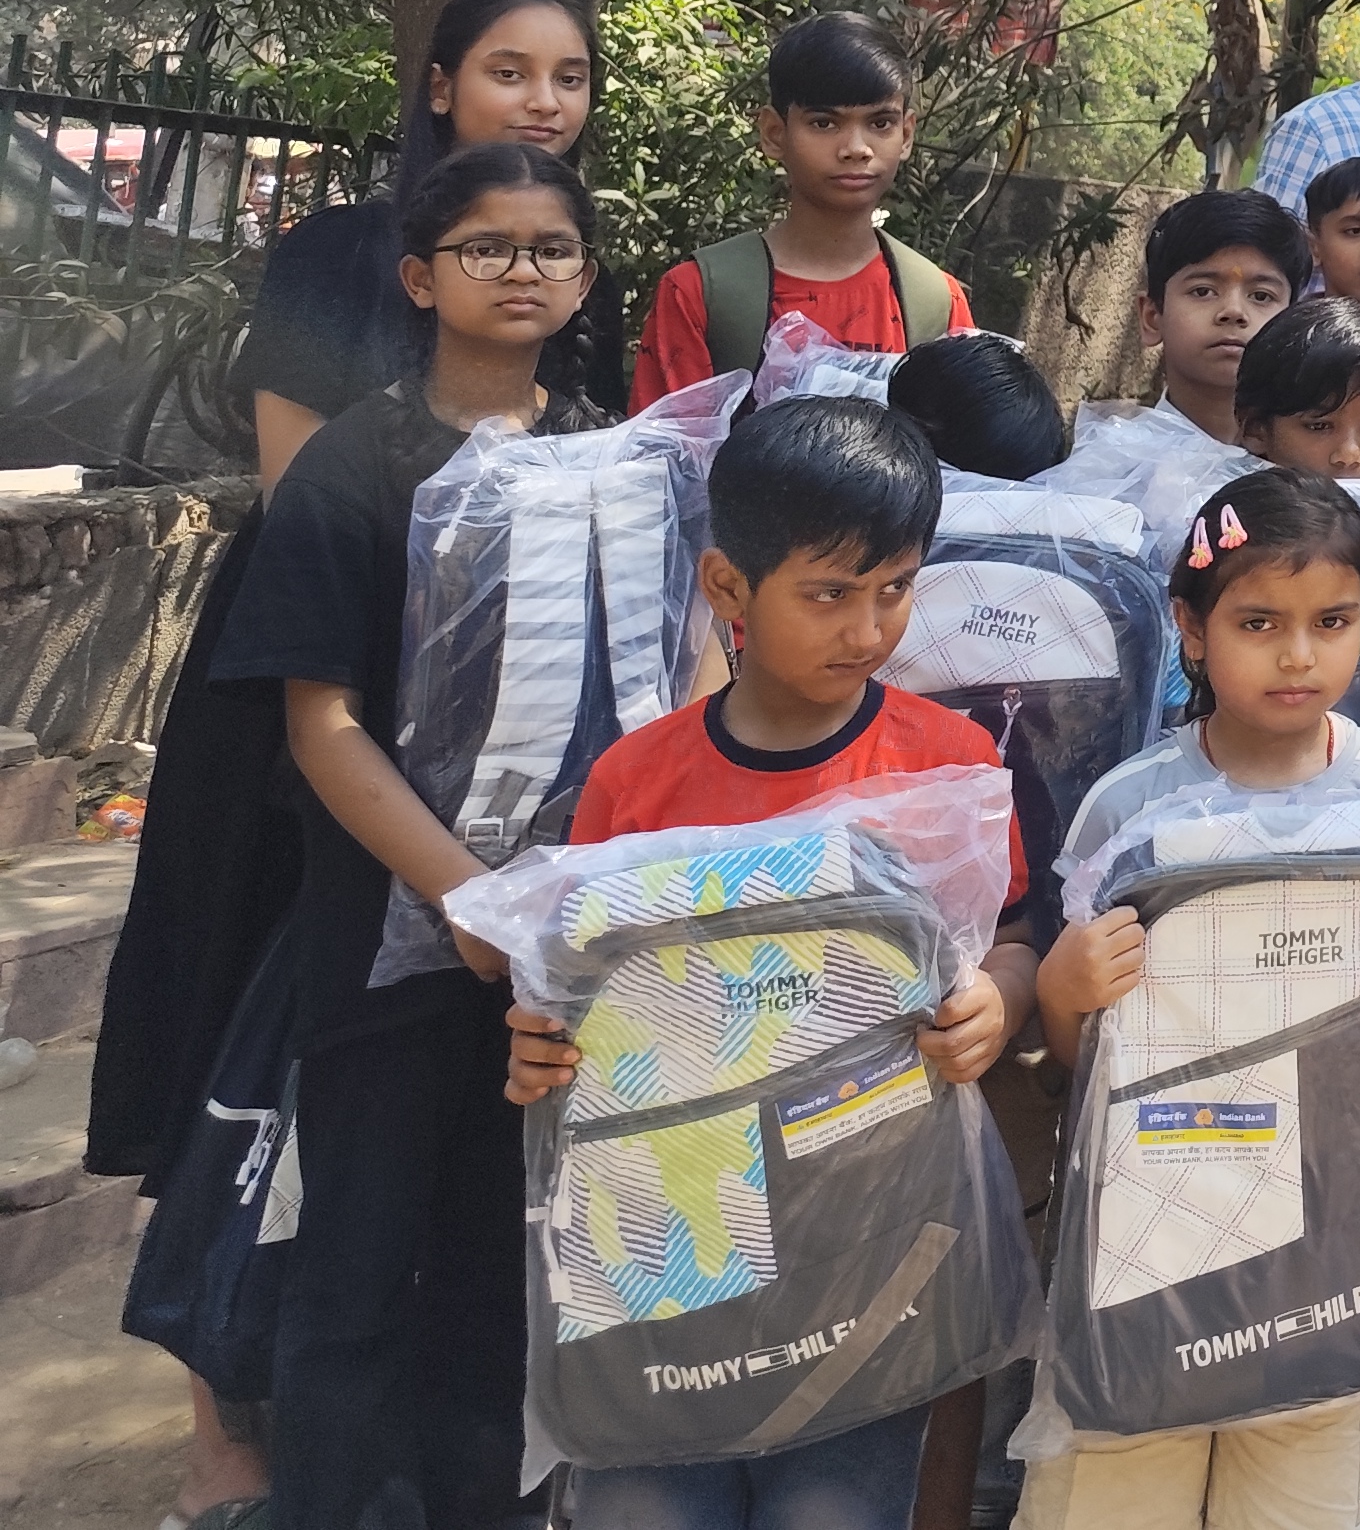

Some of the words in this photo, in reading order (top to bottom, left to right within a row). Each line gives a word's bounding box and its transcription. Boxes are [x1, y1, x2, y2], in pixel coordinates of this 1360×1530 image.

[970, 604, 1040, 628] TOMMY
[961, 619, 1037, 645] HILFIGER
[1259, 926, 1341, 949] TOMMY
[1256, 945, 1344, 968] HILFIGER
[723, 972, 813, 1000] TOMMY
[1175, 1320, 1272, 1371] TOMMY
[643, 1356, 742, 1394] TOMMY
